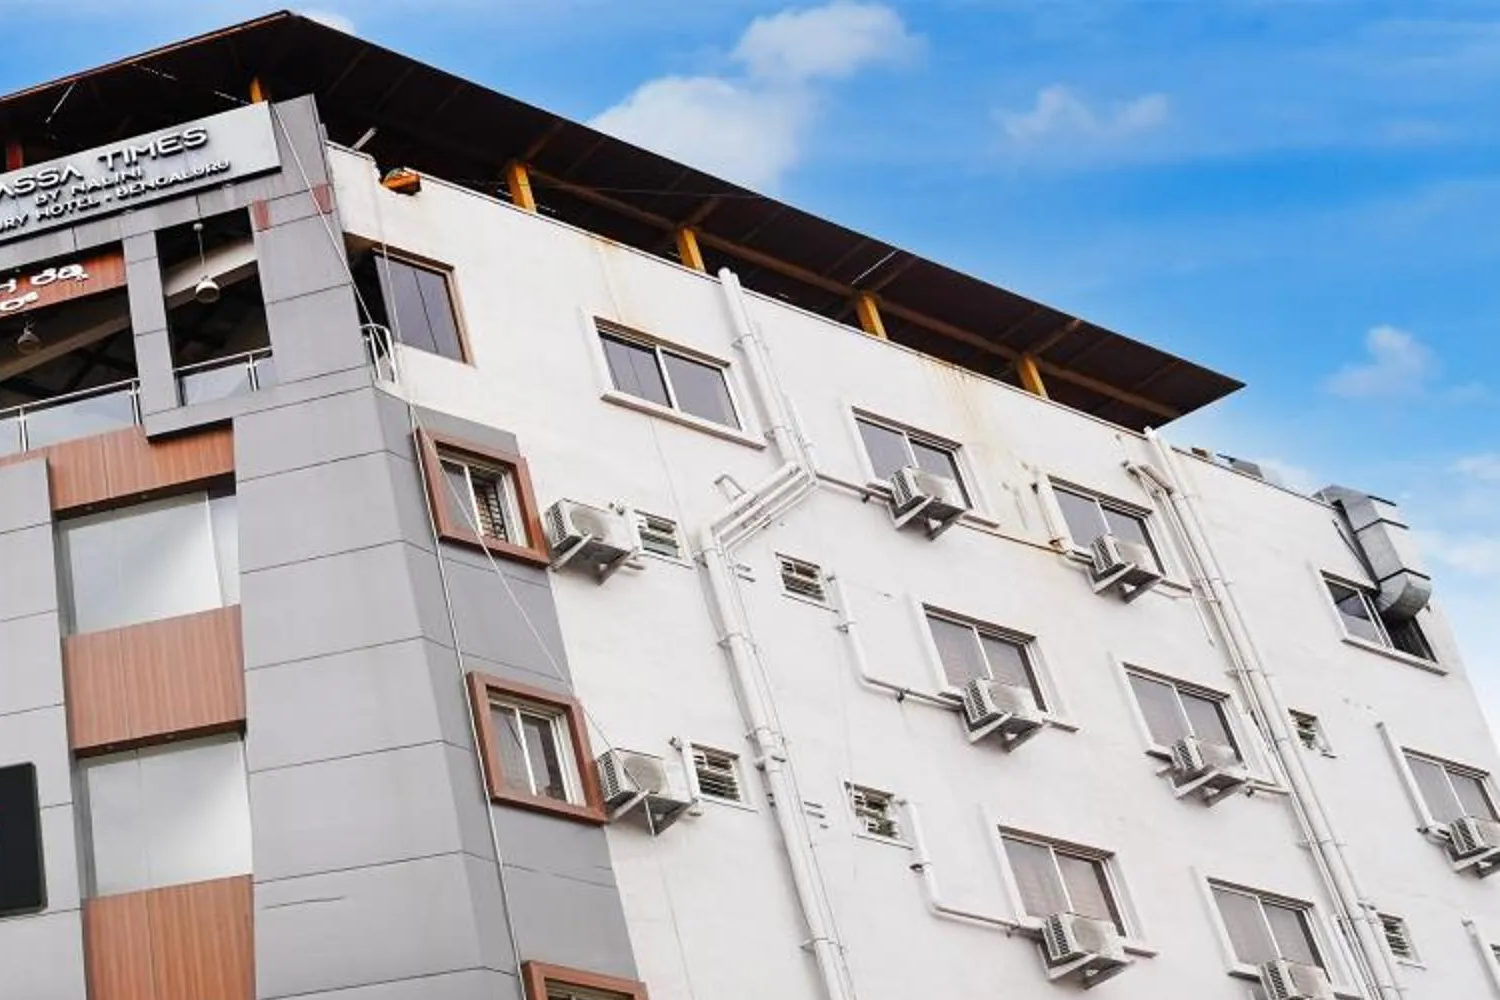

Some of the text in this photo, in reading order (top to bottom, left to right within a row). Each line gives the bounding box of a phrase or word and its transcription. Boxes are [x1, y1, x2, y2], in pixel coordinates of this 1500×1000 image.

[98, 127, 208, 169] TIMES
[36, 167, 143, 206] BY NALINI
[37, 197, 99, 221] HOTEL
[117, 159, 230, 199] BENGALURU
